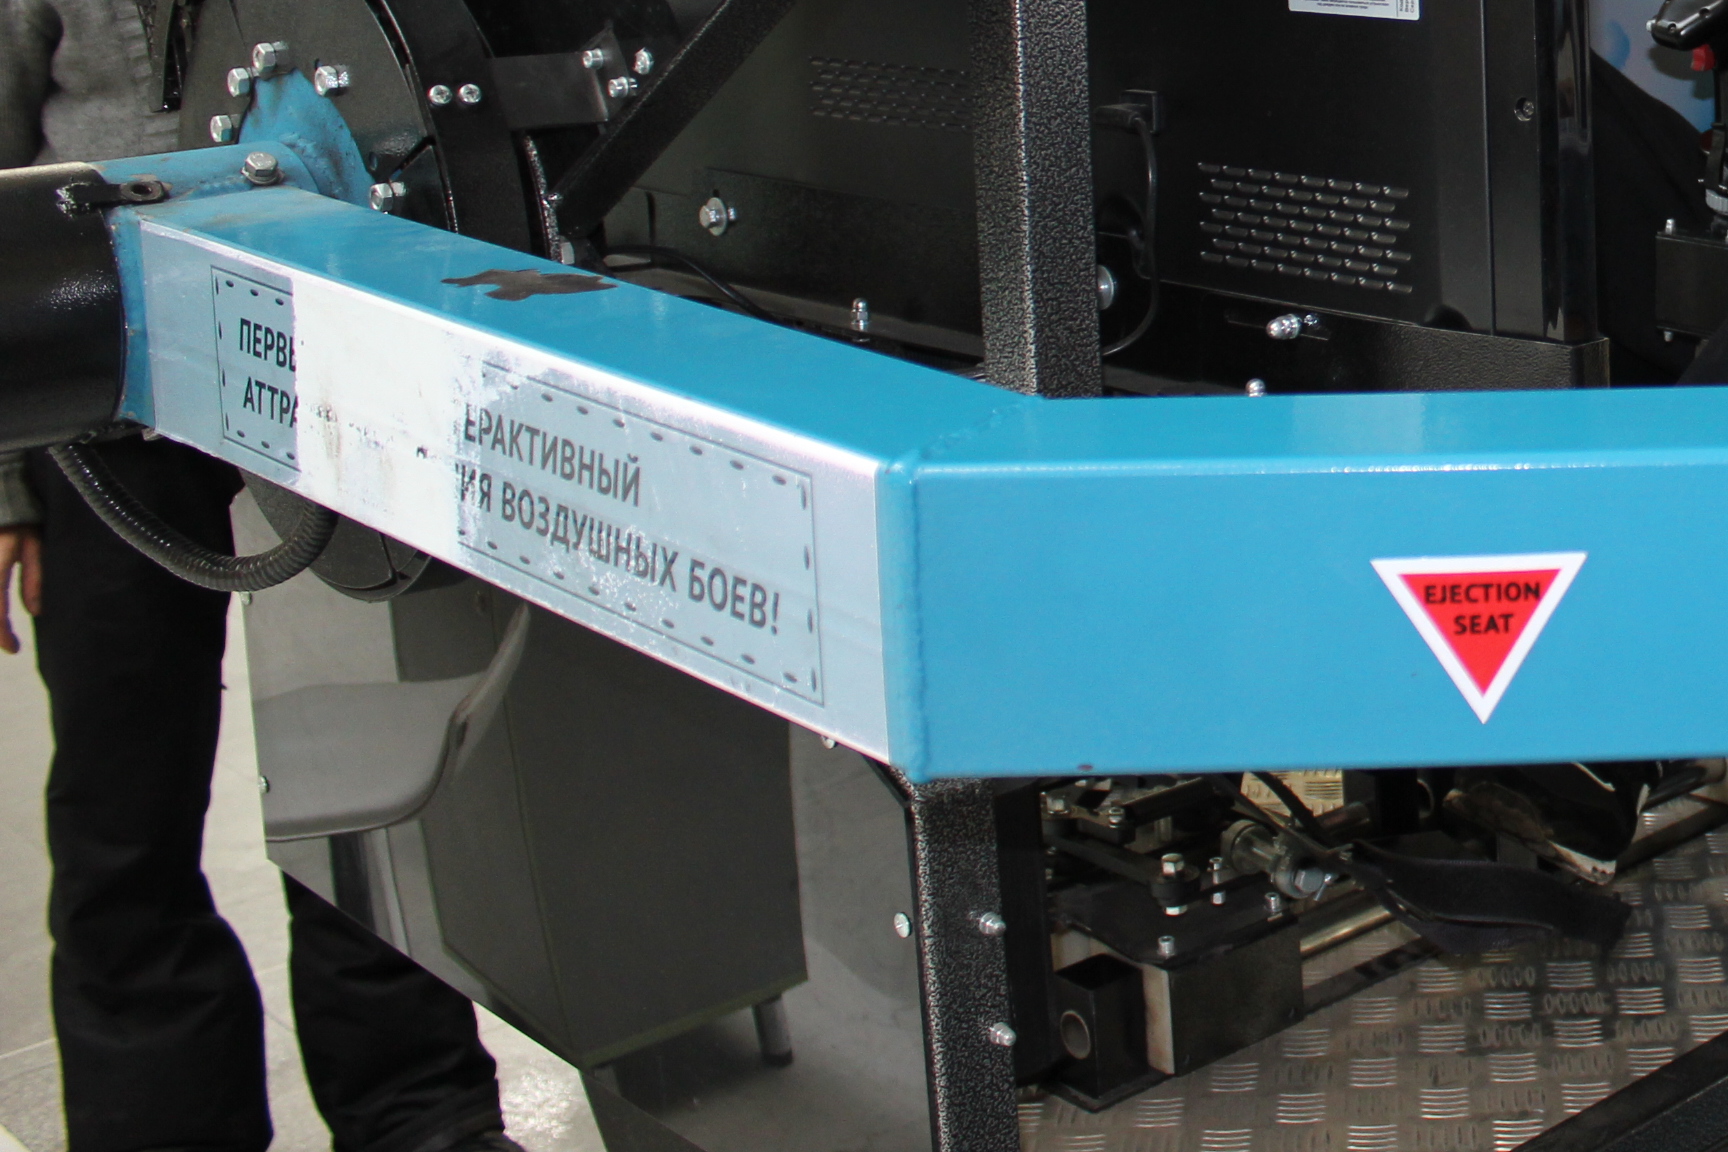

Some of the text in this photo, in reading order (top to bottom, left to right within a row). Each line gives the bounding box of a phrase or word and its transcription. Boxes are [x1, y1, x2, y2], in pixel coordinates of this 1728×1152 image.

[501, 481, 679, 593] ВОЗДУШНЫХ
[687, 558, 780, 636] БОЕВ!
[1424, 582, 1541, 605] EJECTION
[1454, 613, 1514, 635] SEAT
